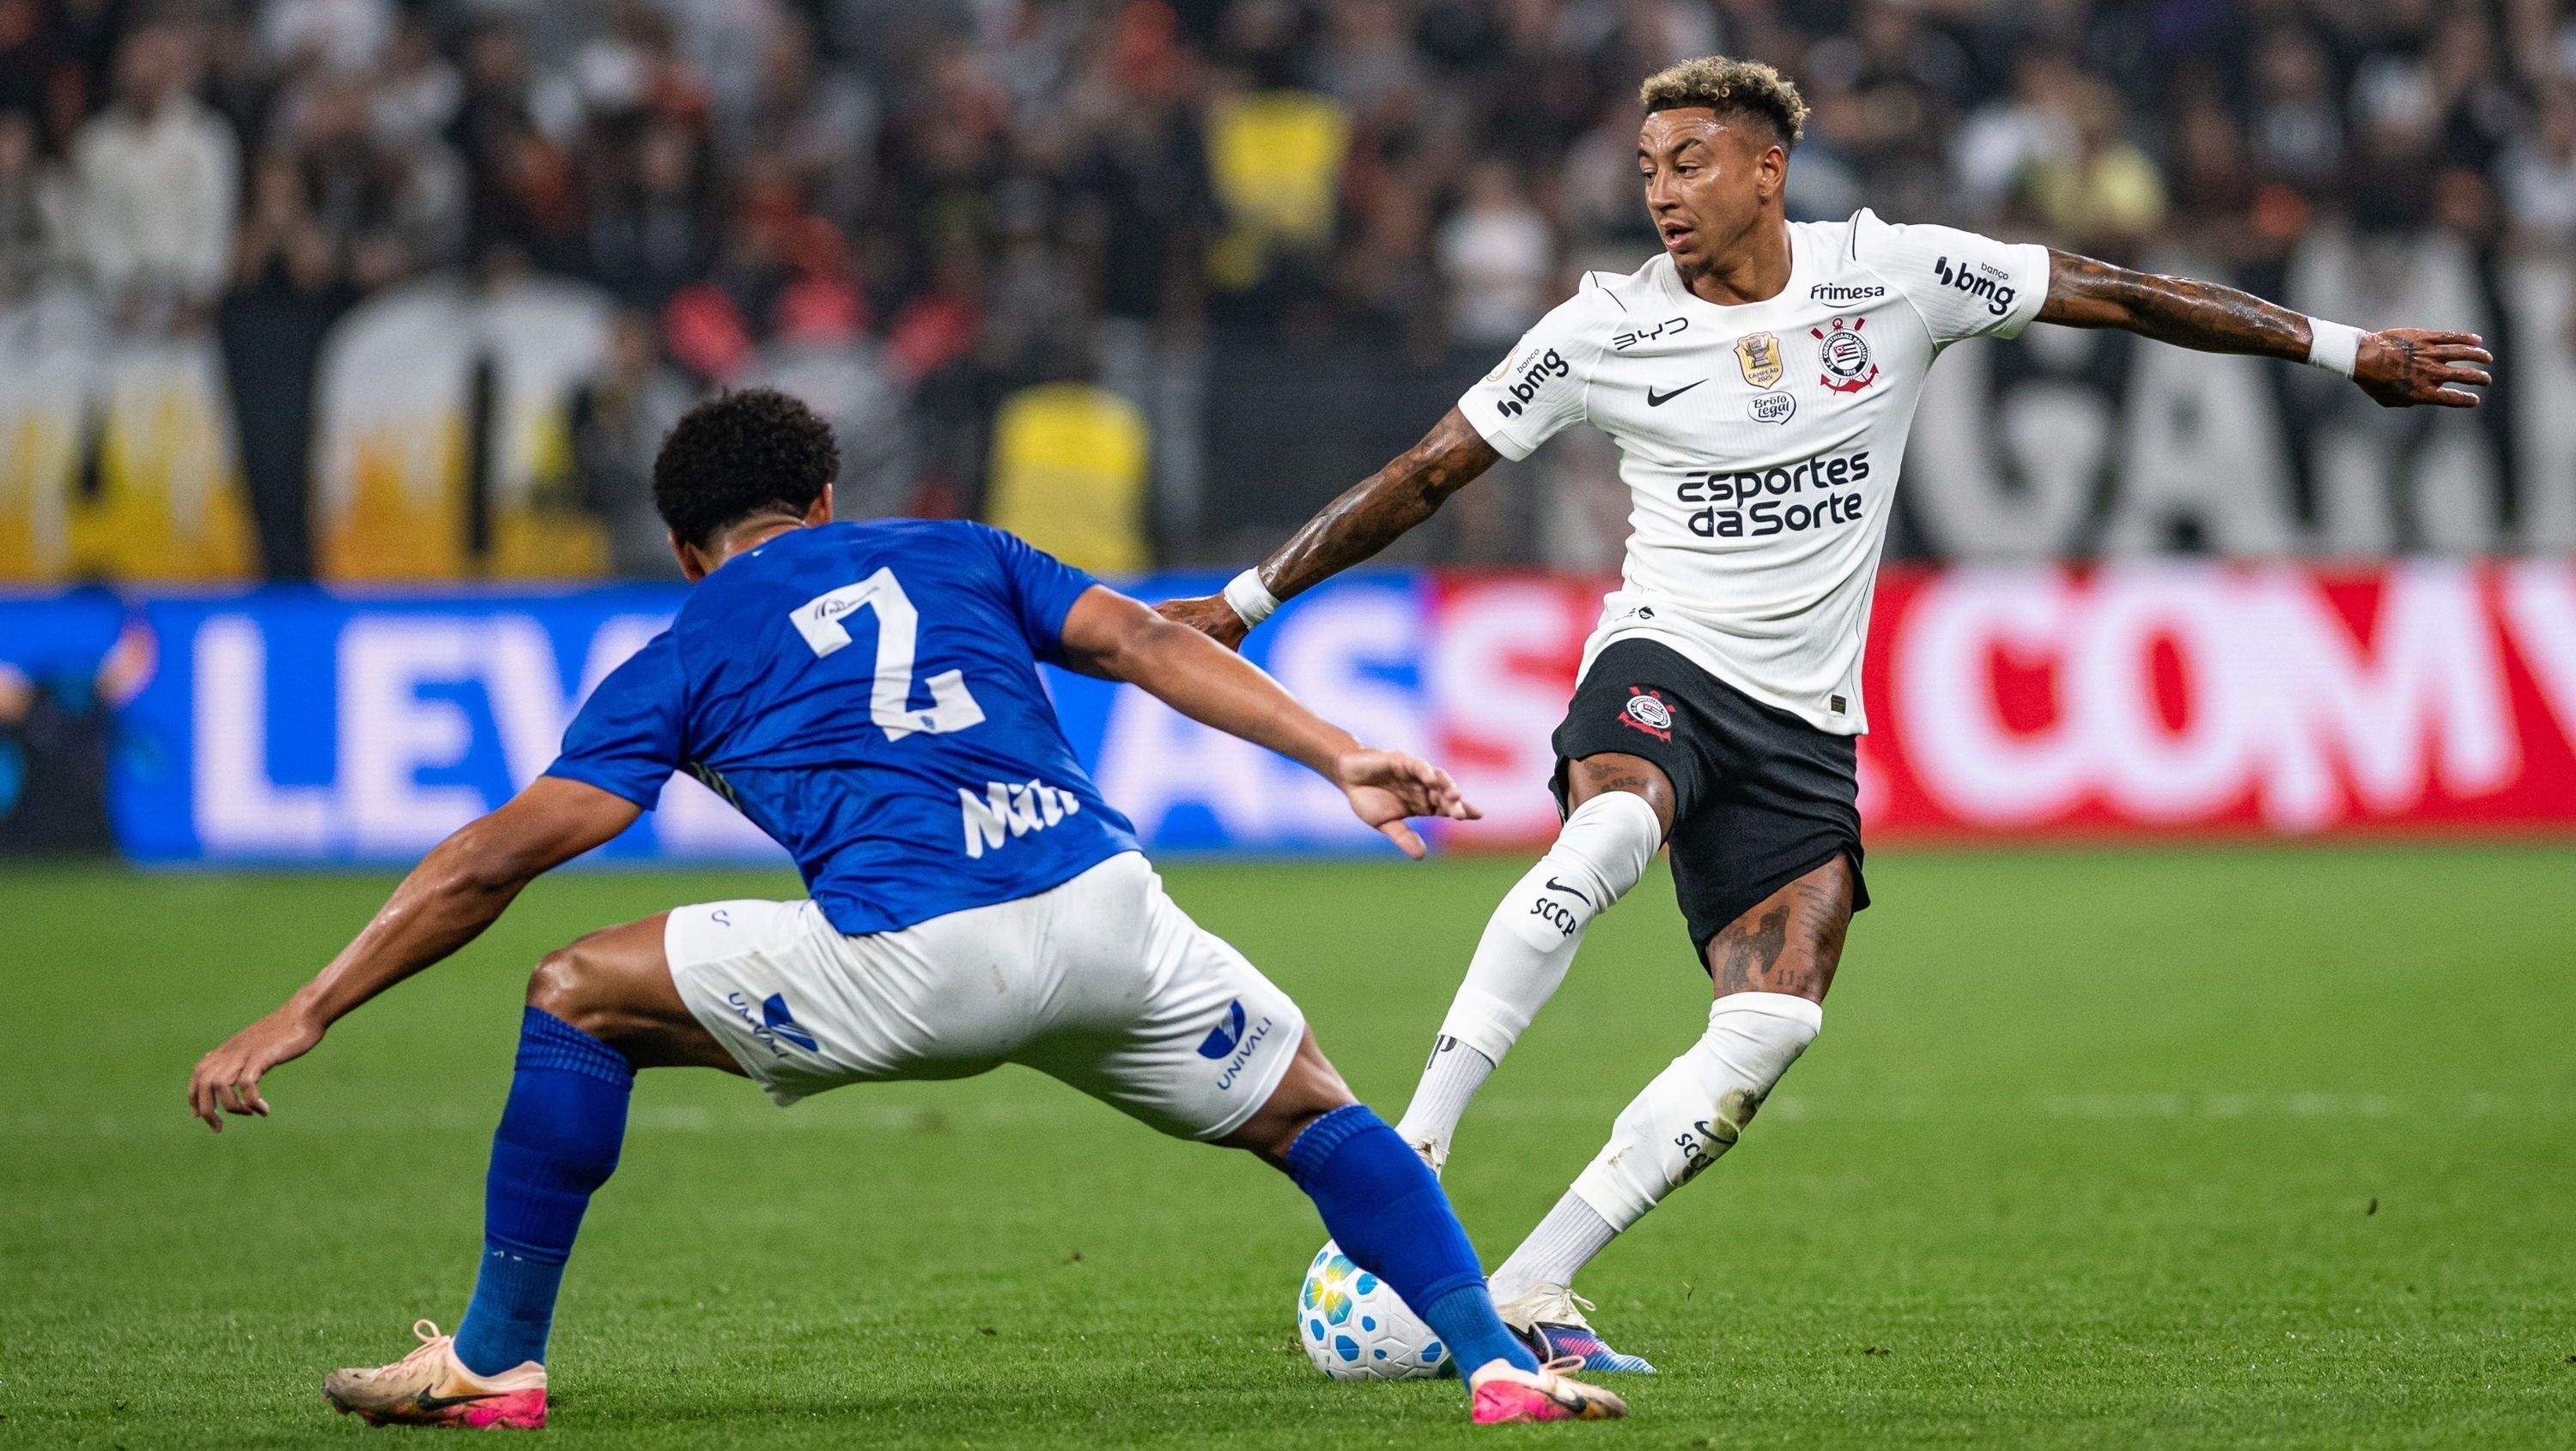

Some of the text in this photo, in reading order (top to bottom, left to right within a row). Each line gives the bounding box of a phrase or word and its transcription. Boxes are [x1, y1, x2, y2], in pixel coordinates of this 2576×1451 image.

[1810, 282, 1885, 301] Frimesa
[1953, 262, 2016, 316] bmg
[1980, 261, 2009, 281] banco
[1613, 316, 1689, 351] BYD
[1509, 347, 1570, 405] bmg
[1516, 348, 1540, 373] banco
[1843, 367, 1856, 376] 1910
[1758, 401, 1789, 418] Legal
[1677, 452, 1869, 508] Esportes
[1688, 492, 1862, 537] da Sorte
[789, 567, 986, 743] 2
[1530, 897, 1577, 938] SCCP
[727, 991, 791, 1059] UNVALI
[1216, 1017, 1273, 1090] UNIVALI
